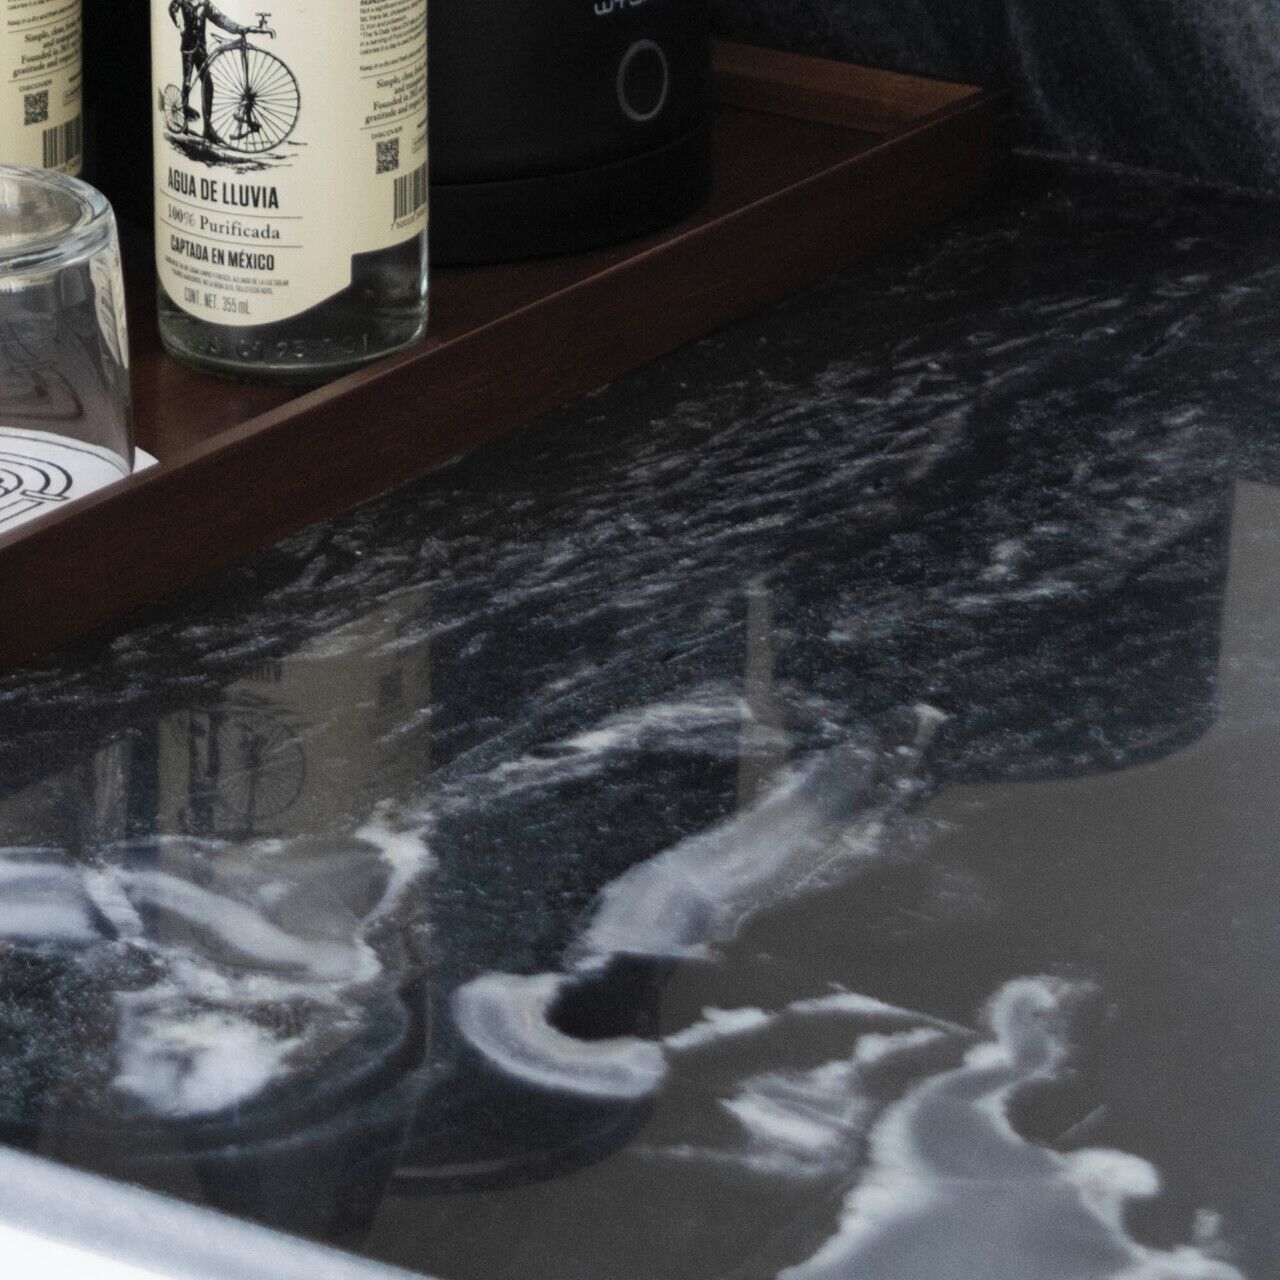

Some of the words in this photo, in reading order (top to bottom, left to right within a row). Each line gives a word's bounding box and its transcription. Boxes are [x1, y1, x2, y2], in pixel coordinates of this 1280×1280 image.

[168, 166, 197, 198] AGUA
[200, 178, 217, 202] DE
[222, 183, 279, 209] LLUVIA
[168, 203, 196, 228] 100%
[200, 215, 280, 240] Purificada
[170, 234, 209, 261] CAPTADA
[211, 248, 225, 266] EN
[228, 249, 275, 271] MÉXICO
[222, 295, 237, 313] 355
